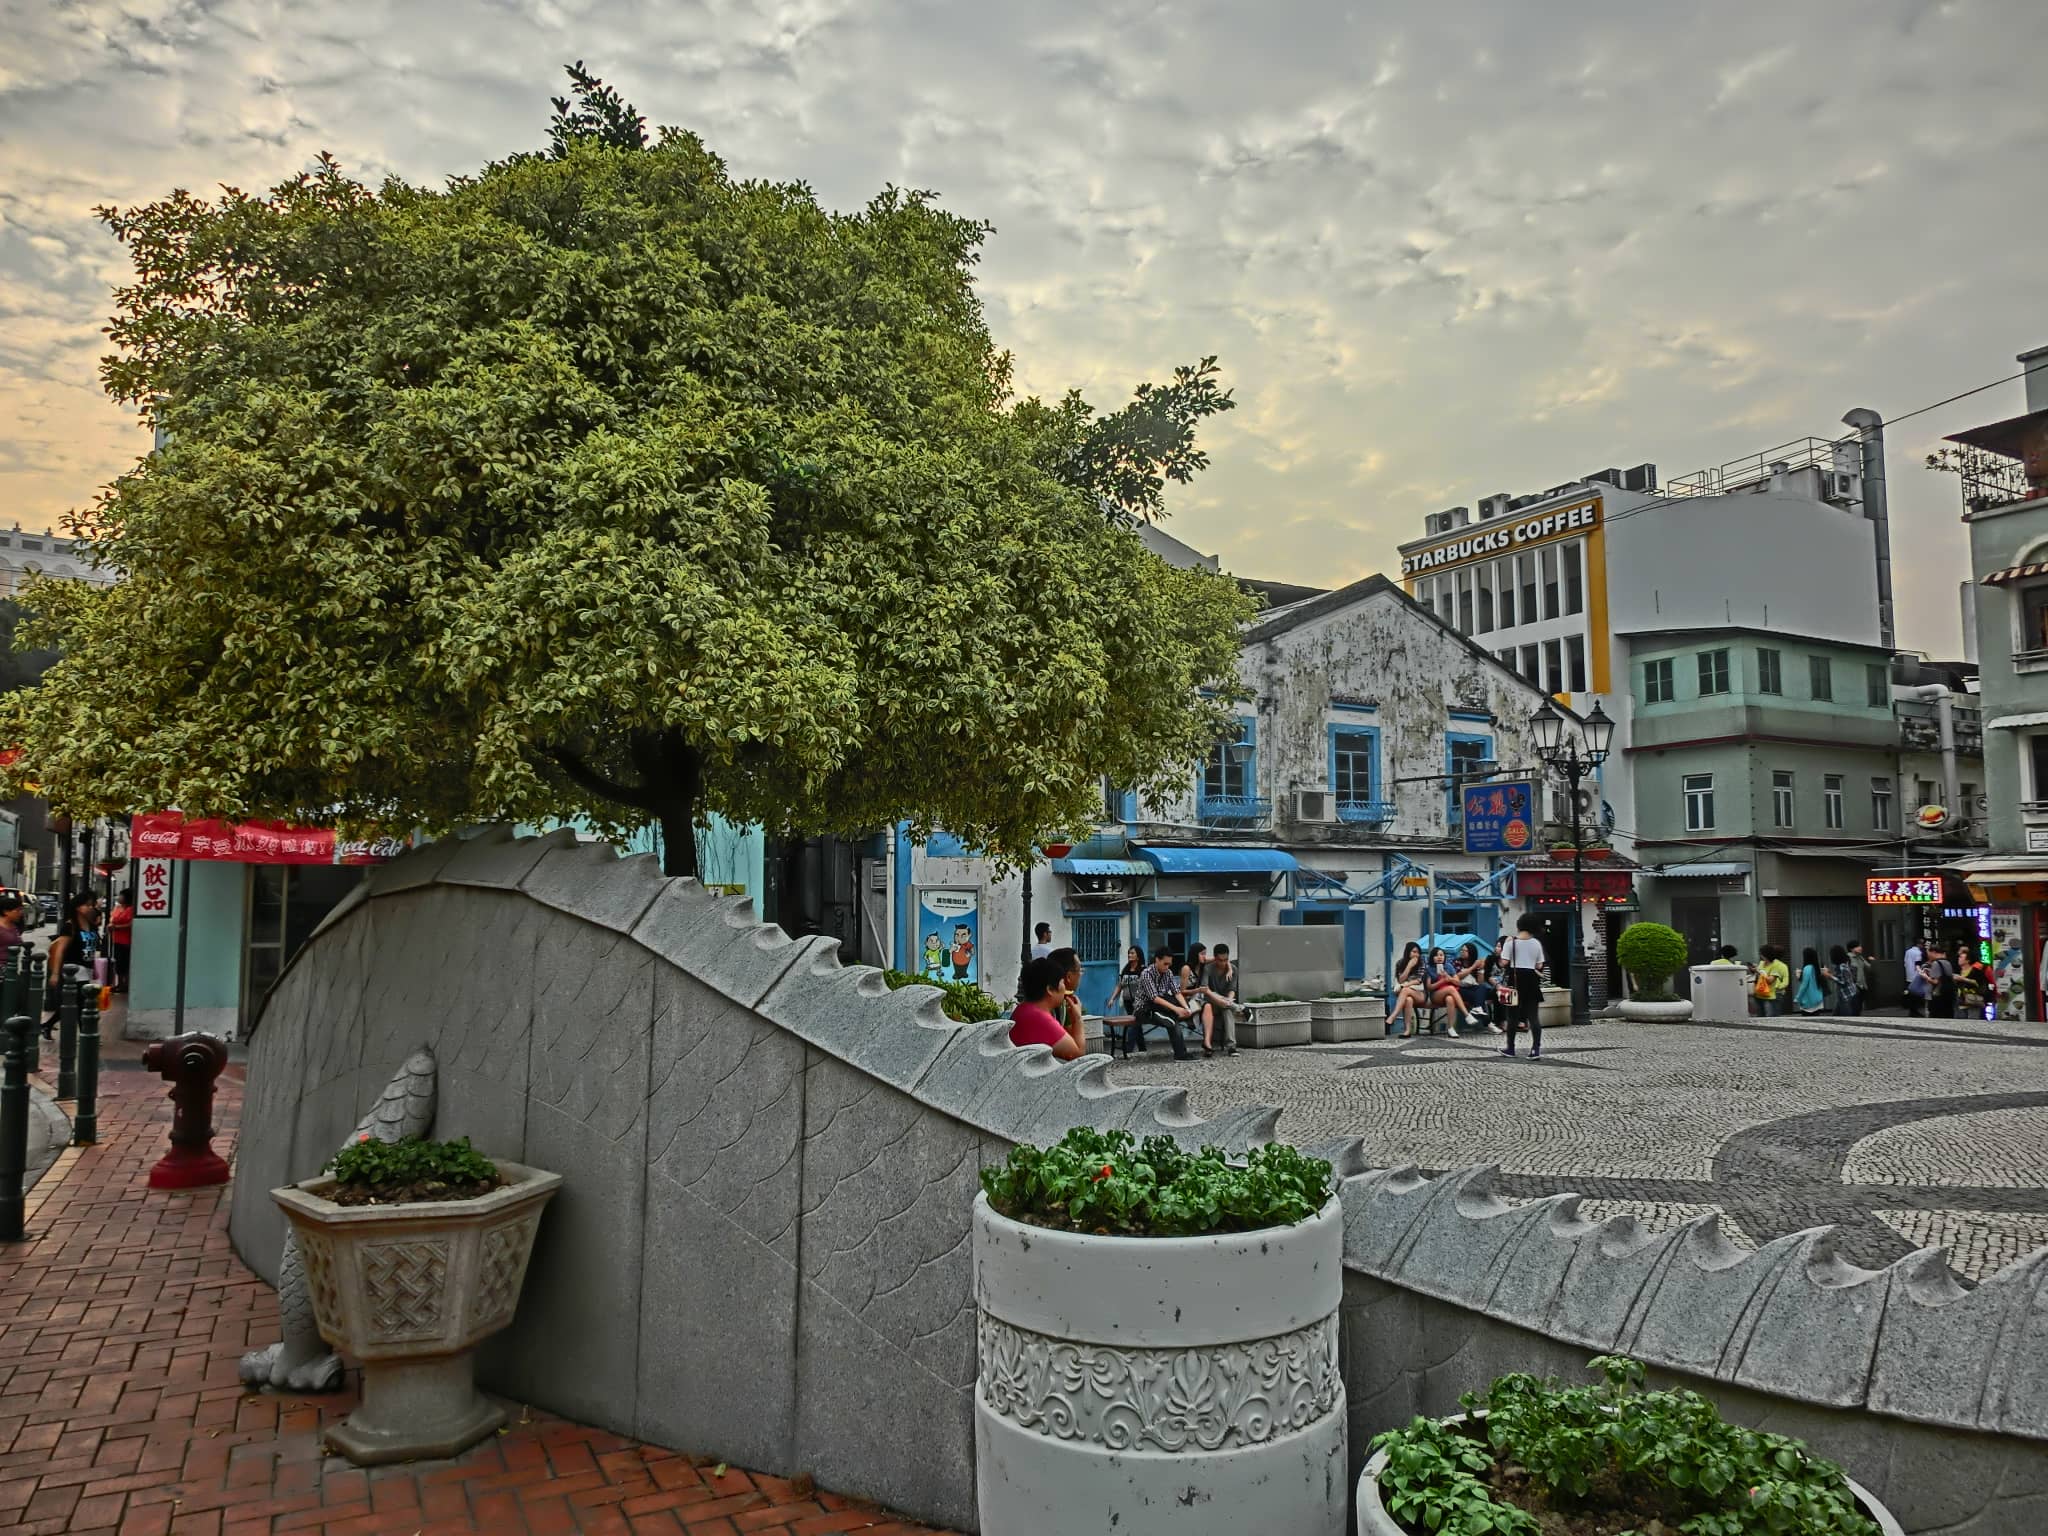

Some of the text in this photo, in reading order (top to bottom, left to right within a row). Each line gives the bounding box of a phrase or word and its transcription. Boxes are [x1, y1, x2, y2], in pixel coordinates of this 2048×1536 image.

[1401, 505, 1594, 574] STARBUCKS COFFEE
[141, 857, 169, 911] 飲品
